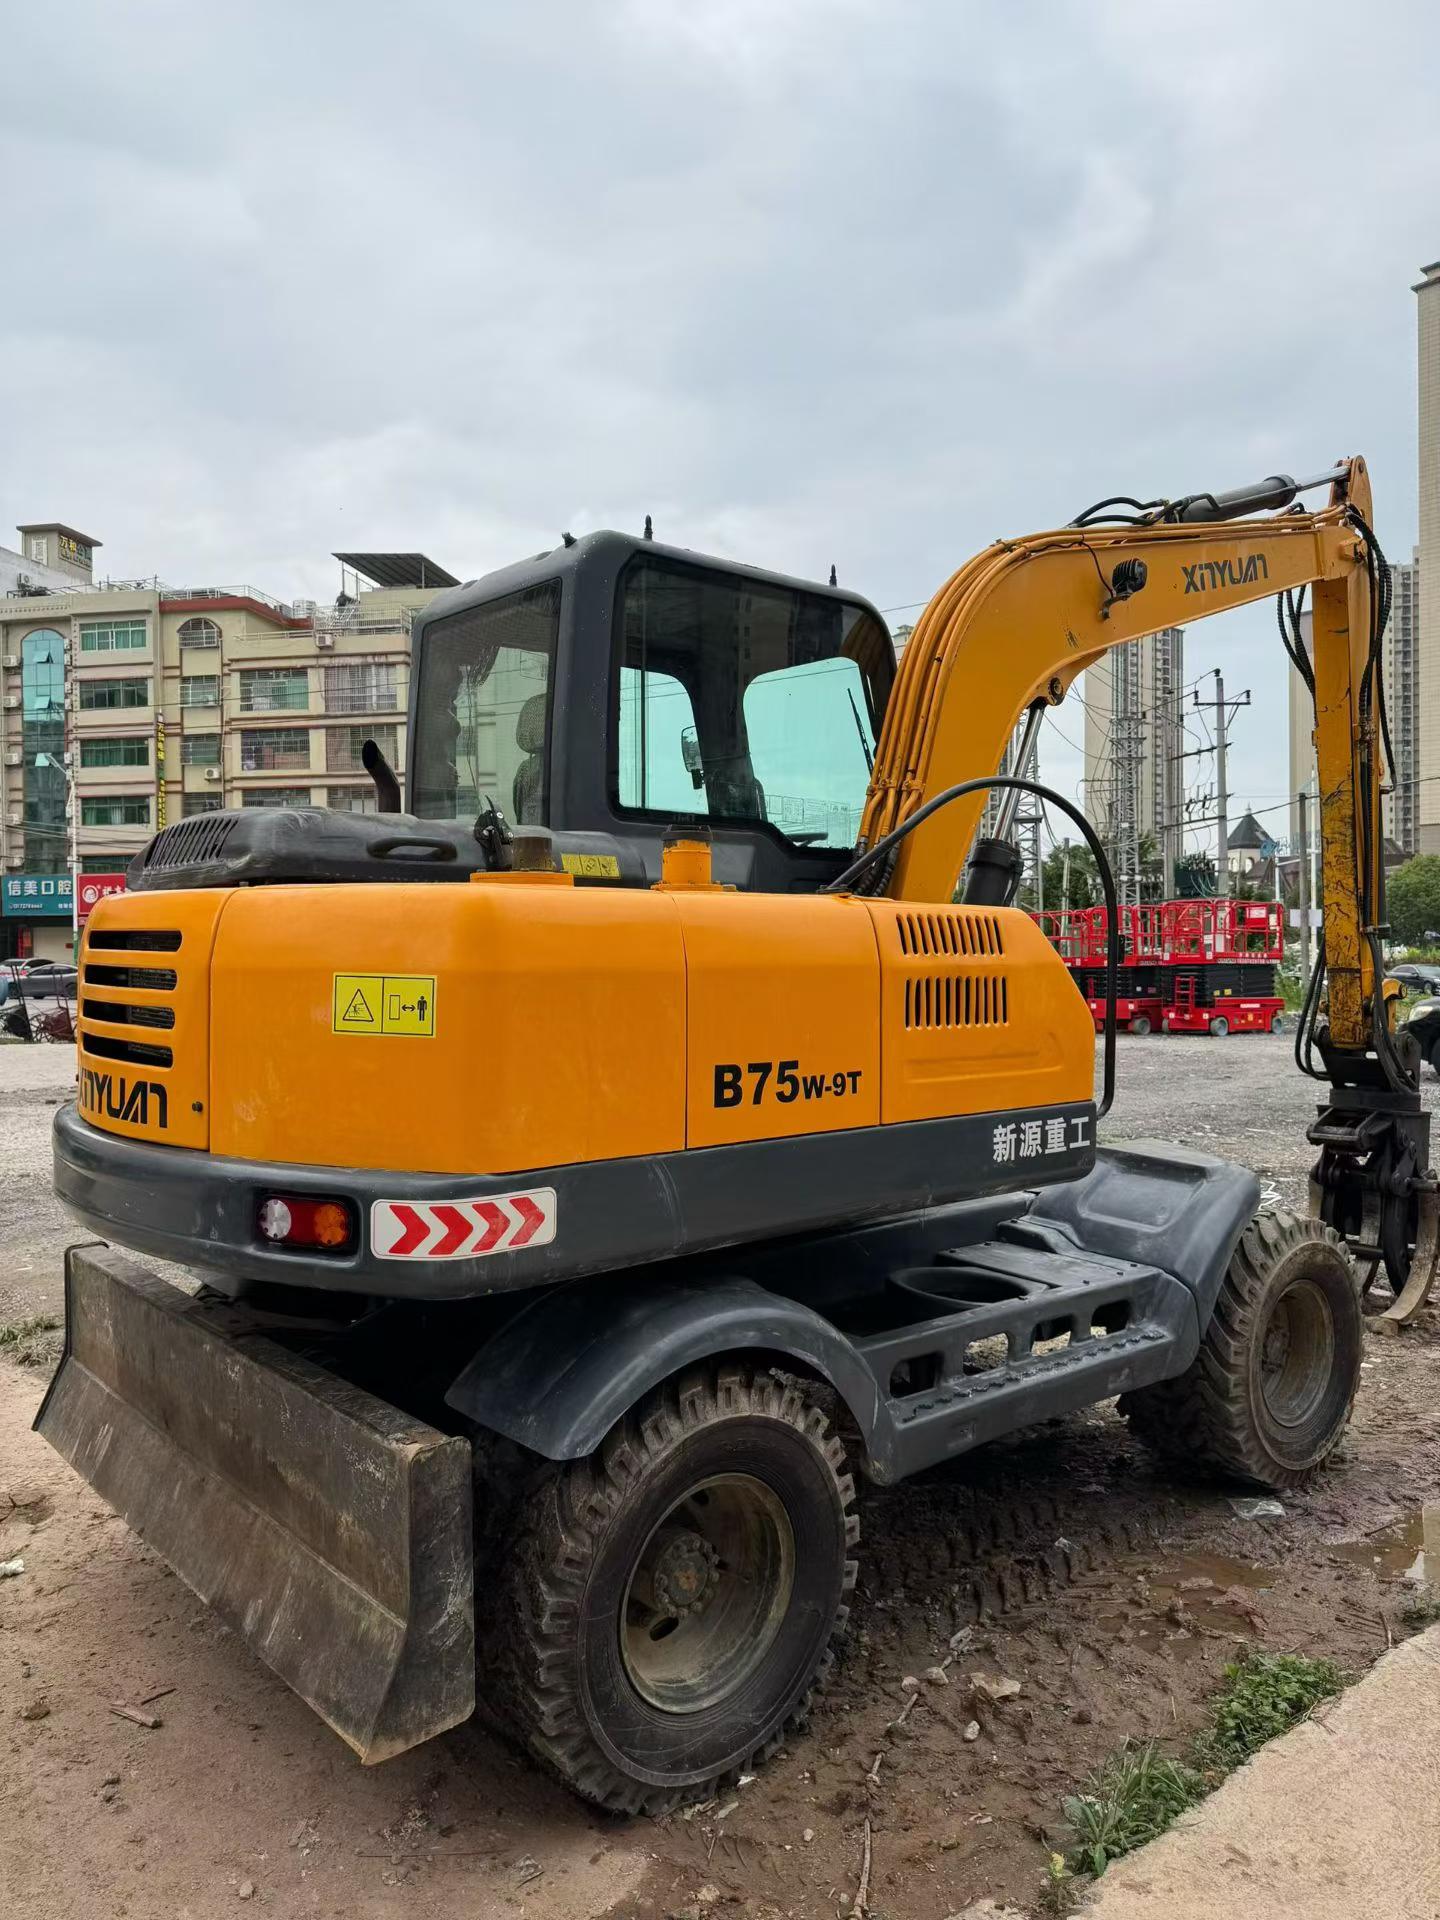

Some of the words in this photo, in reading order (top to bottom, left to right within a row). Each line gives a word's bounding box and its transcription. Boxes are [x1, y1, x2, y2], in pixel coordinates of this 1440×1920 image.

[8, 880, 73, 896] 信美口腔
[993, 1116, 1091, 1163] 新源重工
